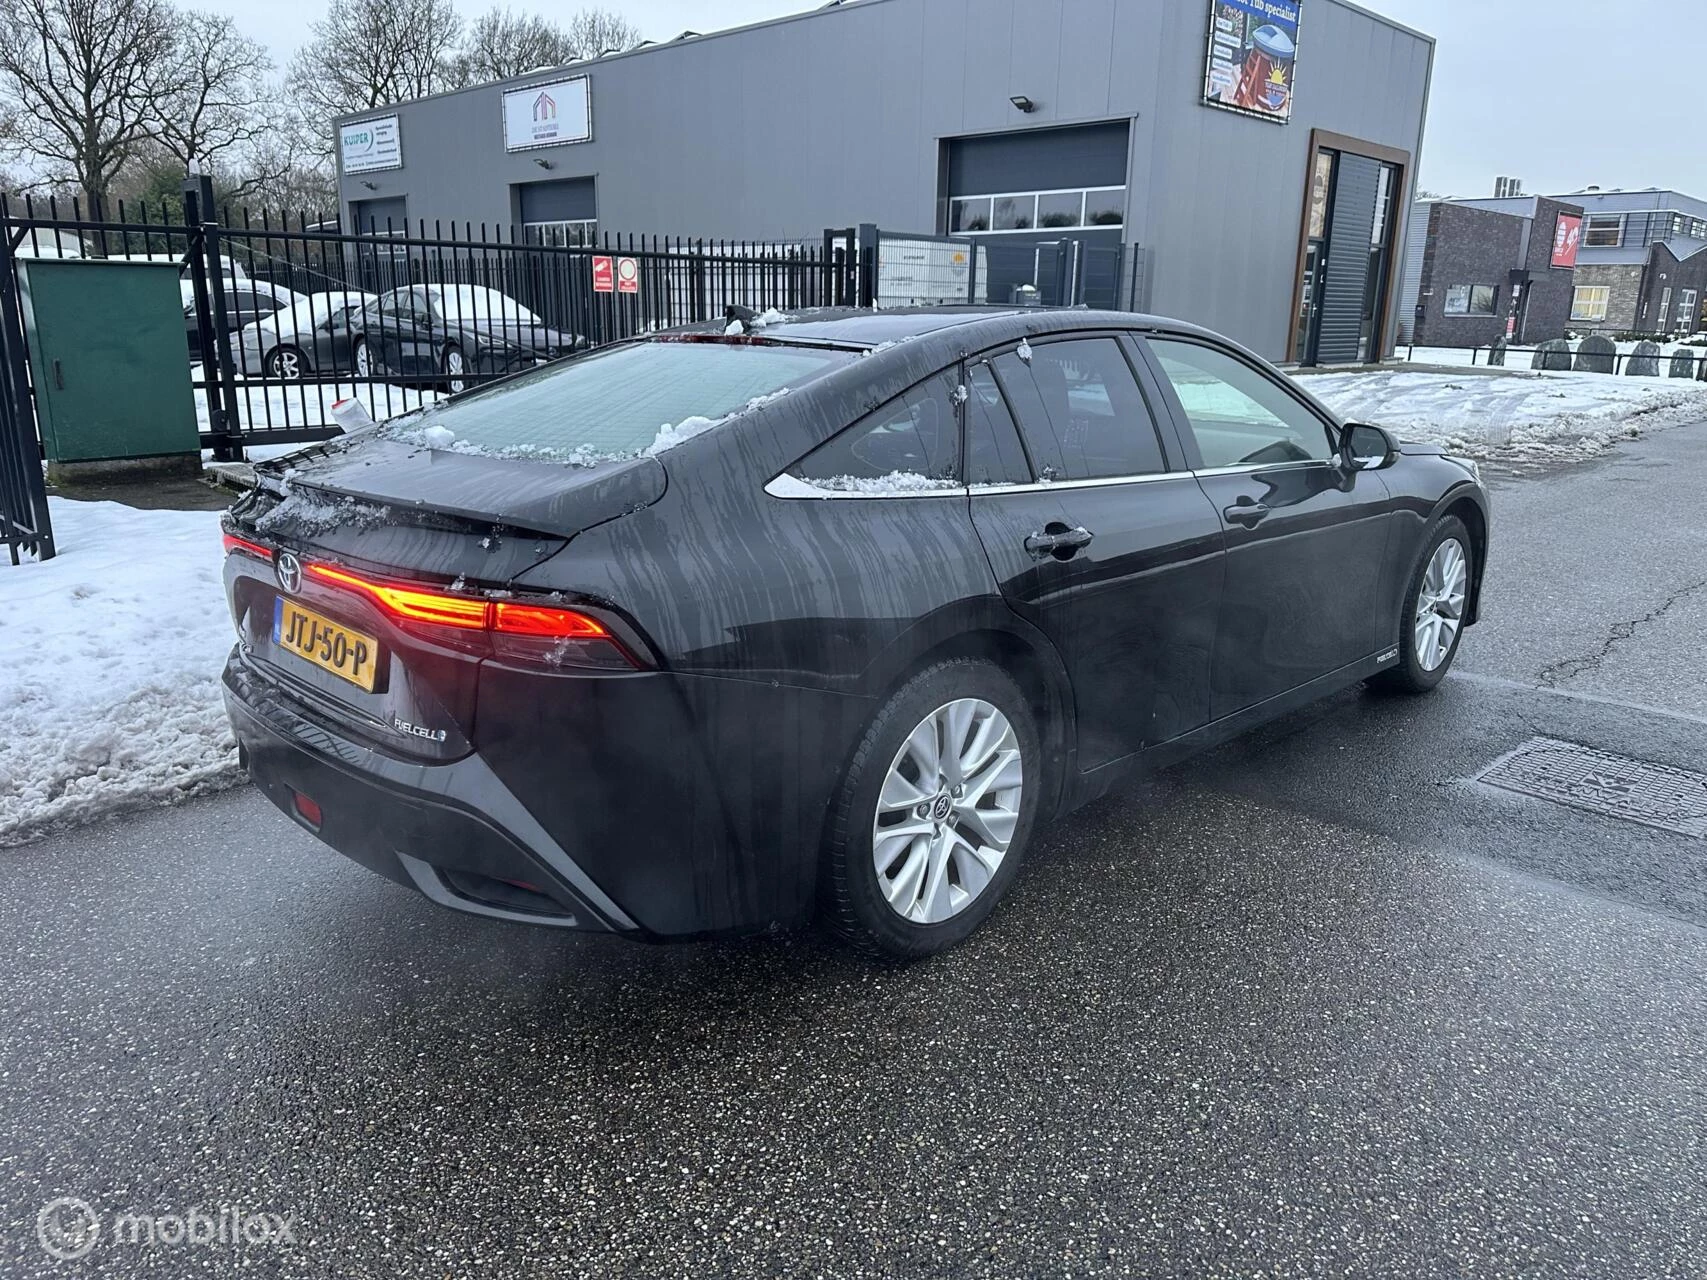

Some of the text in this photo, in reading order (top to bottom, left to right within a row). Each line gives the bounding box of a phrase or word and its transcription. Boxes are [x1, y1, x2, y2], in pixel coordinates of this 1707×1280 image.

[1265, 3, 1296, 22] specialist
[344, 133, 368, 146] KUIPER
[286, 611, 367, 676] JTJ-50-P
